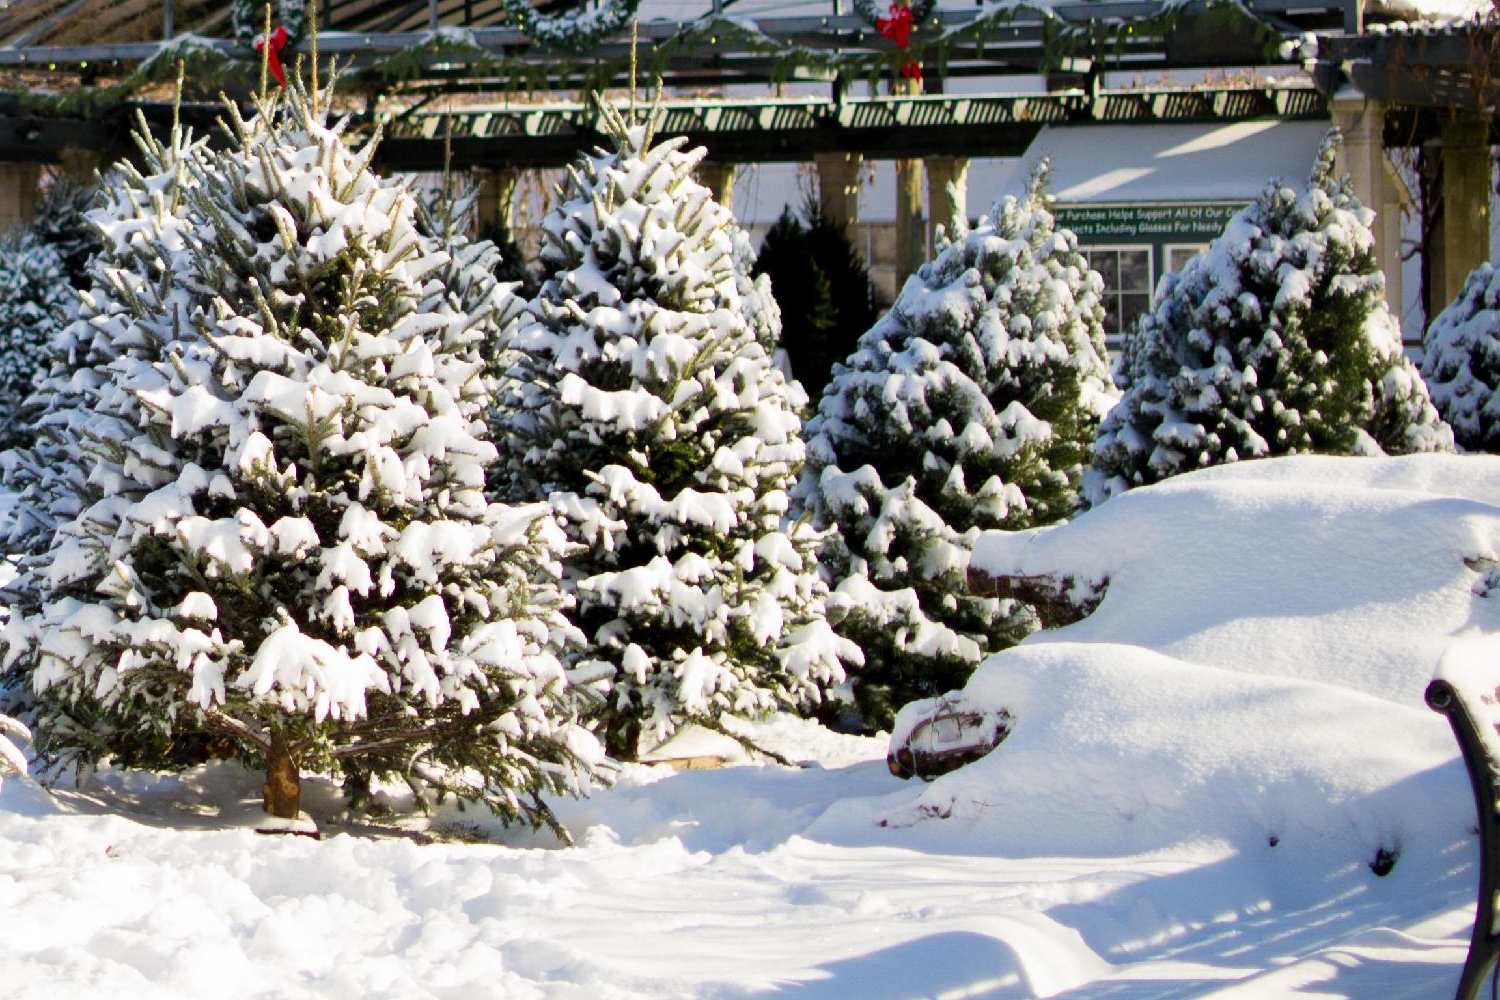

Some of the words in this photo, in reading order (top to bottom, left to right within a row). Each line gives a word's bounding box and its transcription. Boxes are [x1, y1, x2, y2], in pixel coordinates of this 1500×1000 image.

[1067, 210, 1107, 220] Purchase
[1109, 208, 1134, 221] Helps
[1137, 208, 1172, 221] Support
[1175, 207, 1188, 218] All
[1190, 207, 1203, 218] Of
[1206, 207, 1223, 218] Our
[1096, 222, 1137, 236] Including
[1139, 221, 1172, 233] Glasses
[1174, 220, 1190, 232] For
[1193, 220, 1223, 234] Needy
